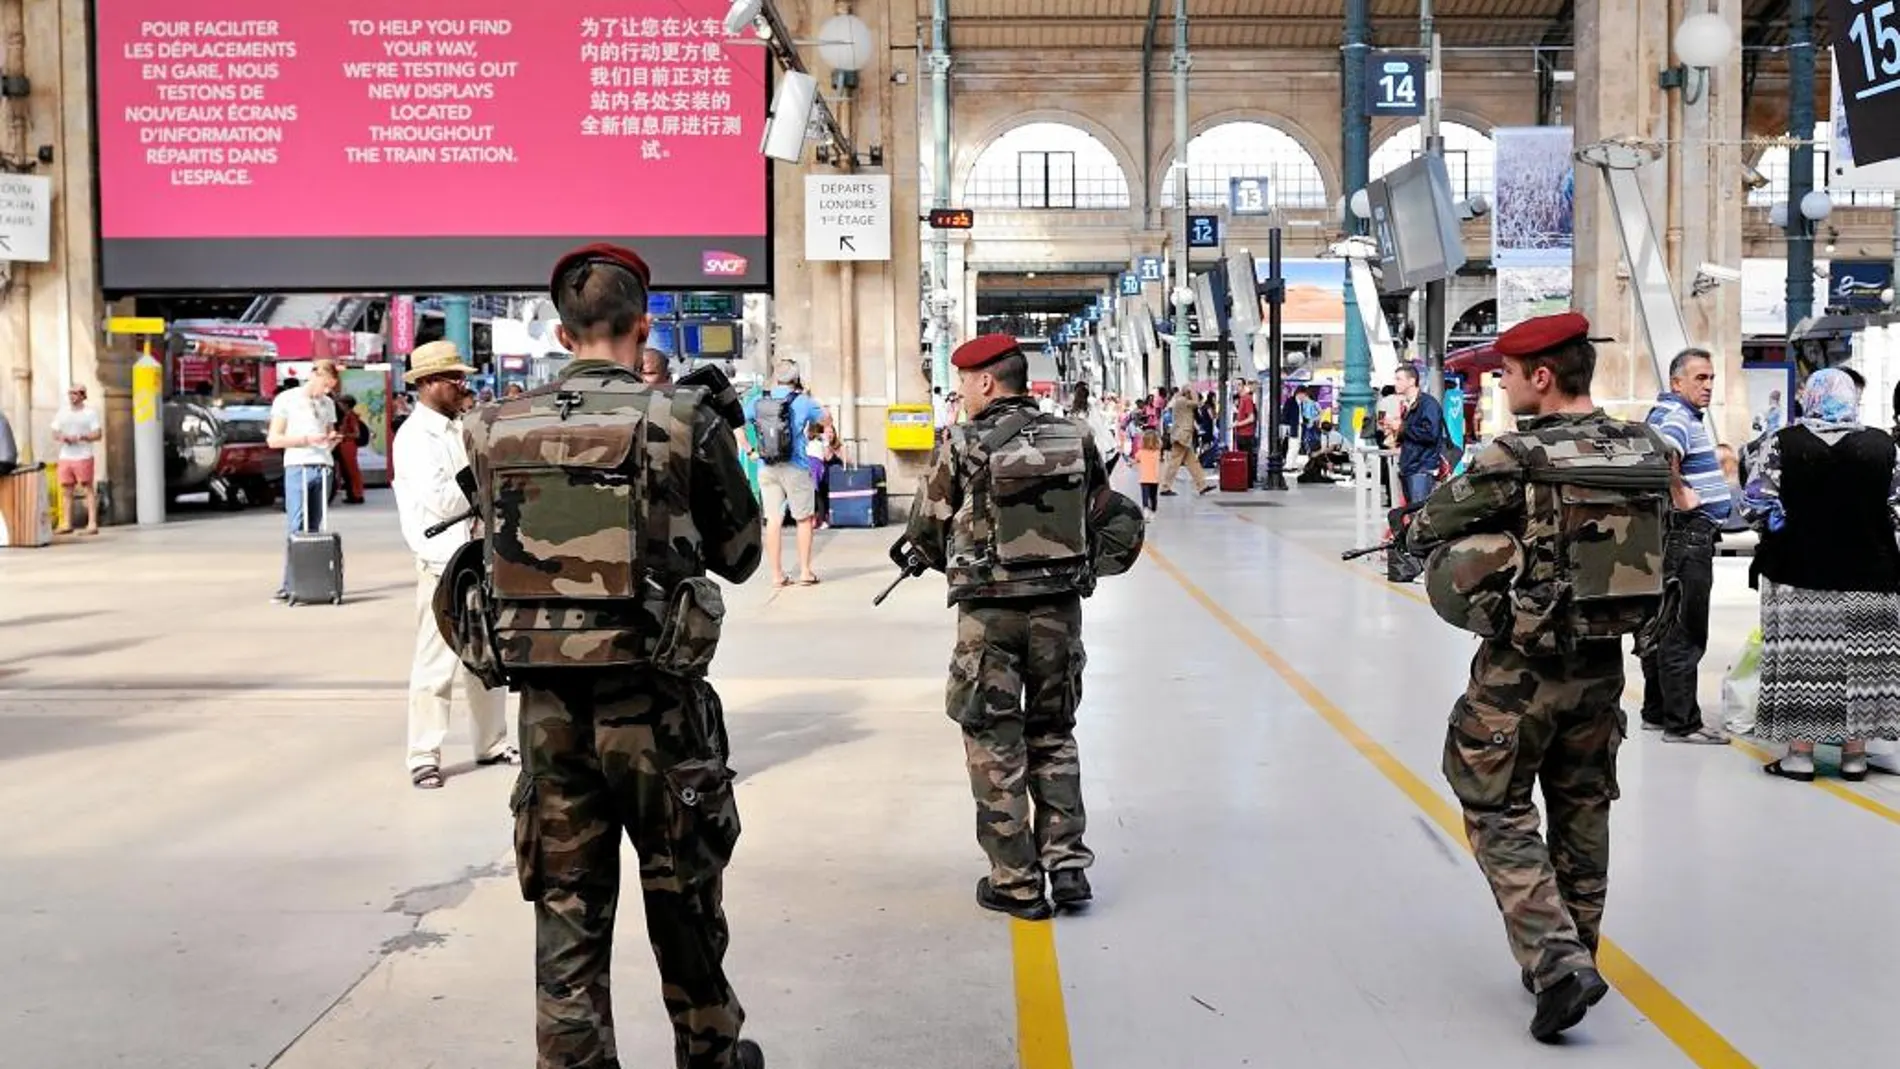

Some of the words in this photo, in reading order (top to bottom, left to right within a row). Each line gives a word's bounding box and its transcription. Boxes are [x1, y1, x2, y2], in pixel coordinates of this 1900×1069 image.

[142, 20, 190, 37] POUR
[194, 20, 279, 37] FACILITER
[349, 19, 375, 36] TO
[379, 19, 423, 36] HELP
[426, 19, 465, 36] YOU
[469, 19, 512, 36] FIND
[124, 42, 154, 58] LES
[158, 40, 297, 58] DÉPLACEMENTS
[383, 41, 433, 57] YOUR
[436, 41, 477, 59] WAY,
[1849, 1, 1900, 82] 15
[142, 63, 167, 79] EN
[171, 63, 224, 80] GARE,
[228, 63, 279, 79] NOUS
[343, 62, 398, 78] WE'RE
[402, 62, 476, 78] TESTING
[480, 62, 518, 78] OUT
[590, 66, 732, 87] 我们目前正对在
[157, 84, 236, 100] TESTONS
[240, 84, 264, 100] DE
[368, 83, 412, 99] NEW
[414, 83, 494, 99] DISPLAYS
[1379, 75, 1416, 102] 14
[590, 91, 731, 111] 站内各处安装的
[125, 105, 223, 122] NOUVEAUX
[227, 103, 298, 122] ÉCRANS
[391, 104, 473, 121] LOCATED
[369, 125, 495, 142] THROUGHOUT
[580, 115, 742, 136] 全新信息屏进行测
[140, 127, 283, 144] D'INFORMATION
[146, 146, 224, 164] RÉPARTIS
[228, 147, 278, 164] DANS
[345, 146, 380, 163] THE
[383, 146, 436, 163] TRAIN
[440, 146, 518, 163] STATION.
[171, 169, 253, 185] L'ESPACE.
[821, 182, 875, 194] DÉPARTS
[819, 199, 877, 210] LONDRES
[1238, 189, 1262, 206] 13
[838, 213, 875, 225] ÉTAGE
[1192, 226, 1213, 241] 12
[704, 259, 739, 272] SNCF
